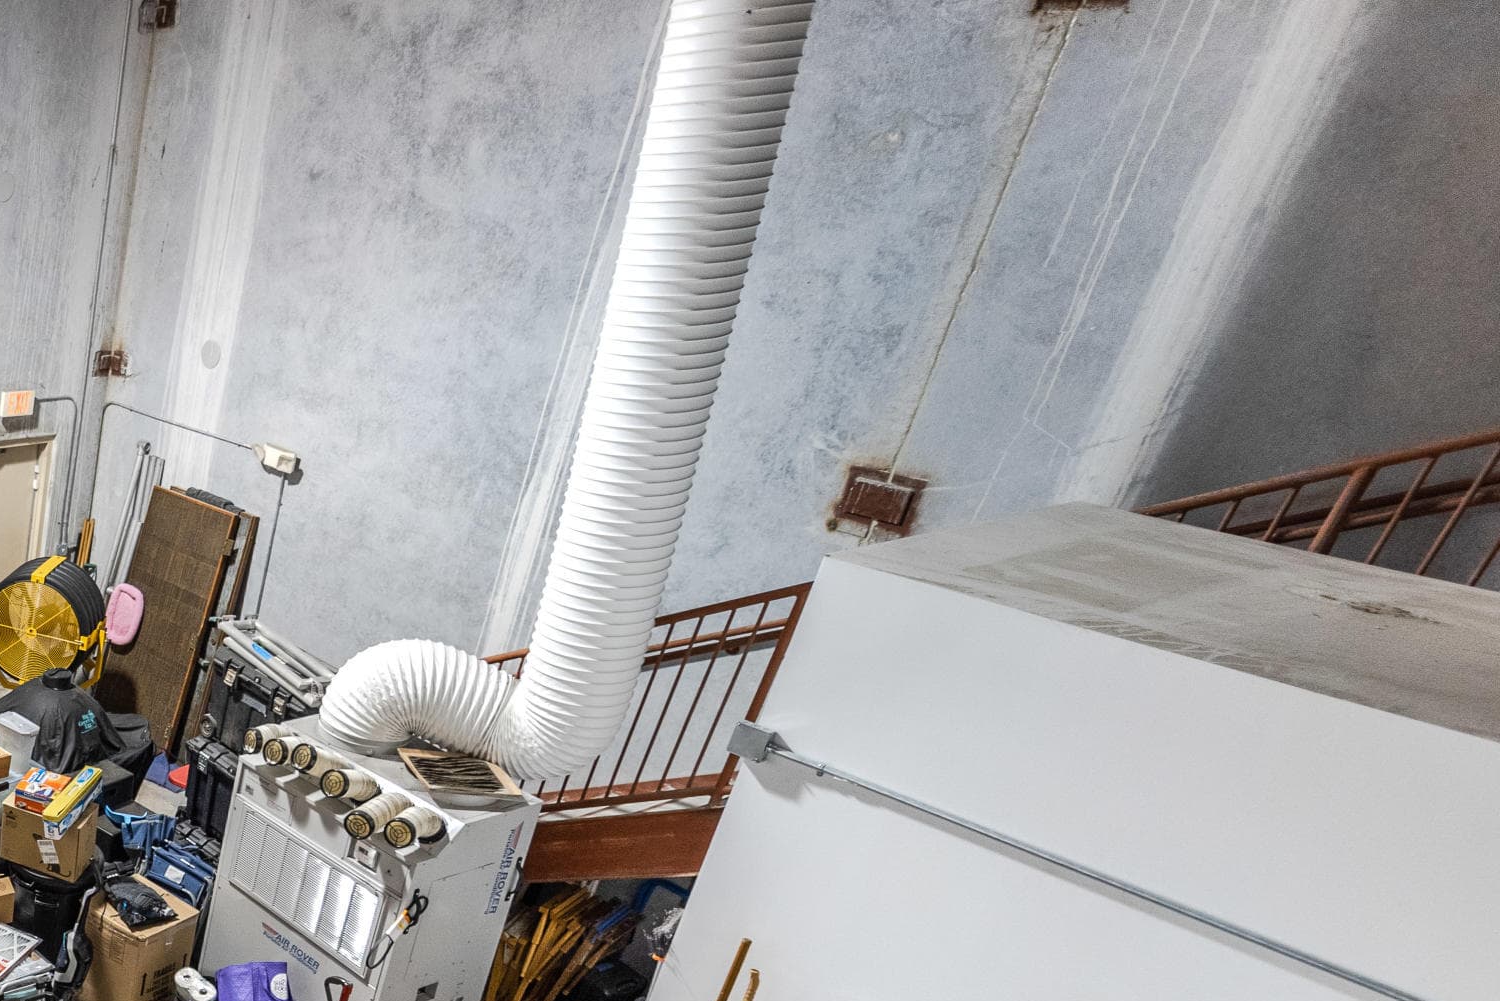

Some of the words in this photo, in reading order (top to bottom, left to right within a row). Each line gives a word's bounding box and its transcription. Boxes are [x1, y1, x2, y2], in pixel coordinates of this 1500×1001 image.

[504, 847, 516, 869] AIR
[489, 871, 509, 914] ROVER
[276, 934, 290, 948] AIR
[291, 945, 320, 969] ROVER
